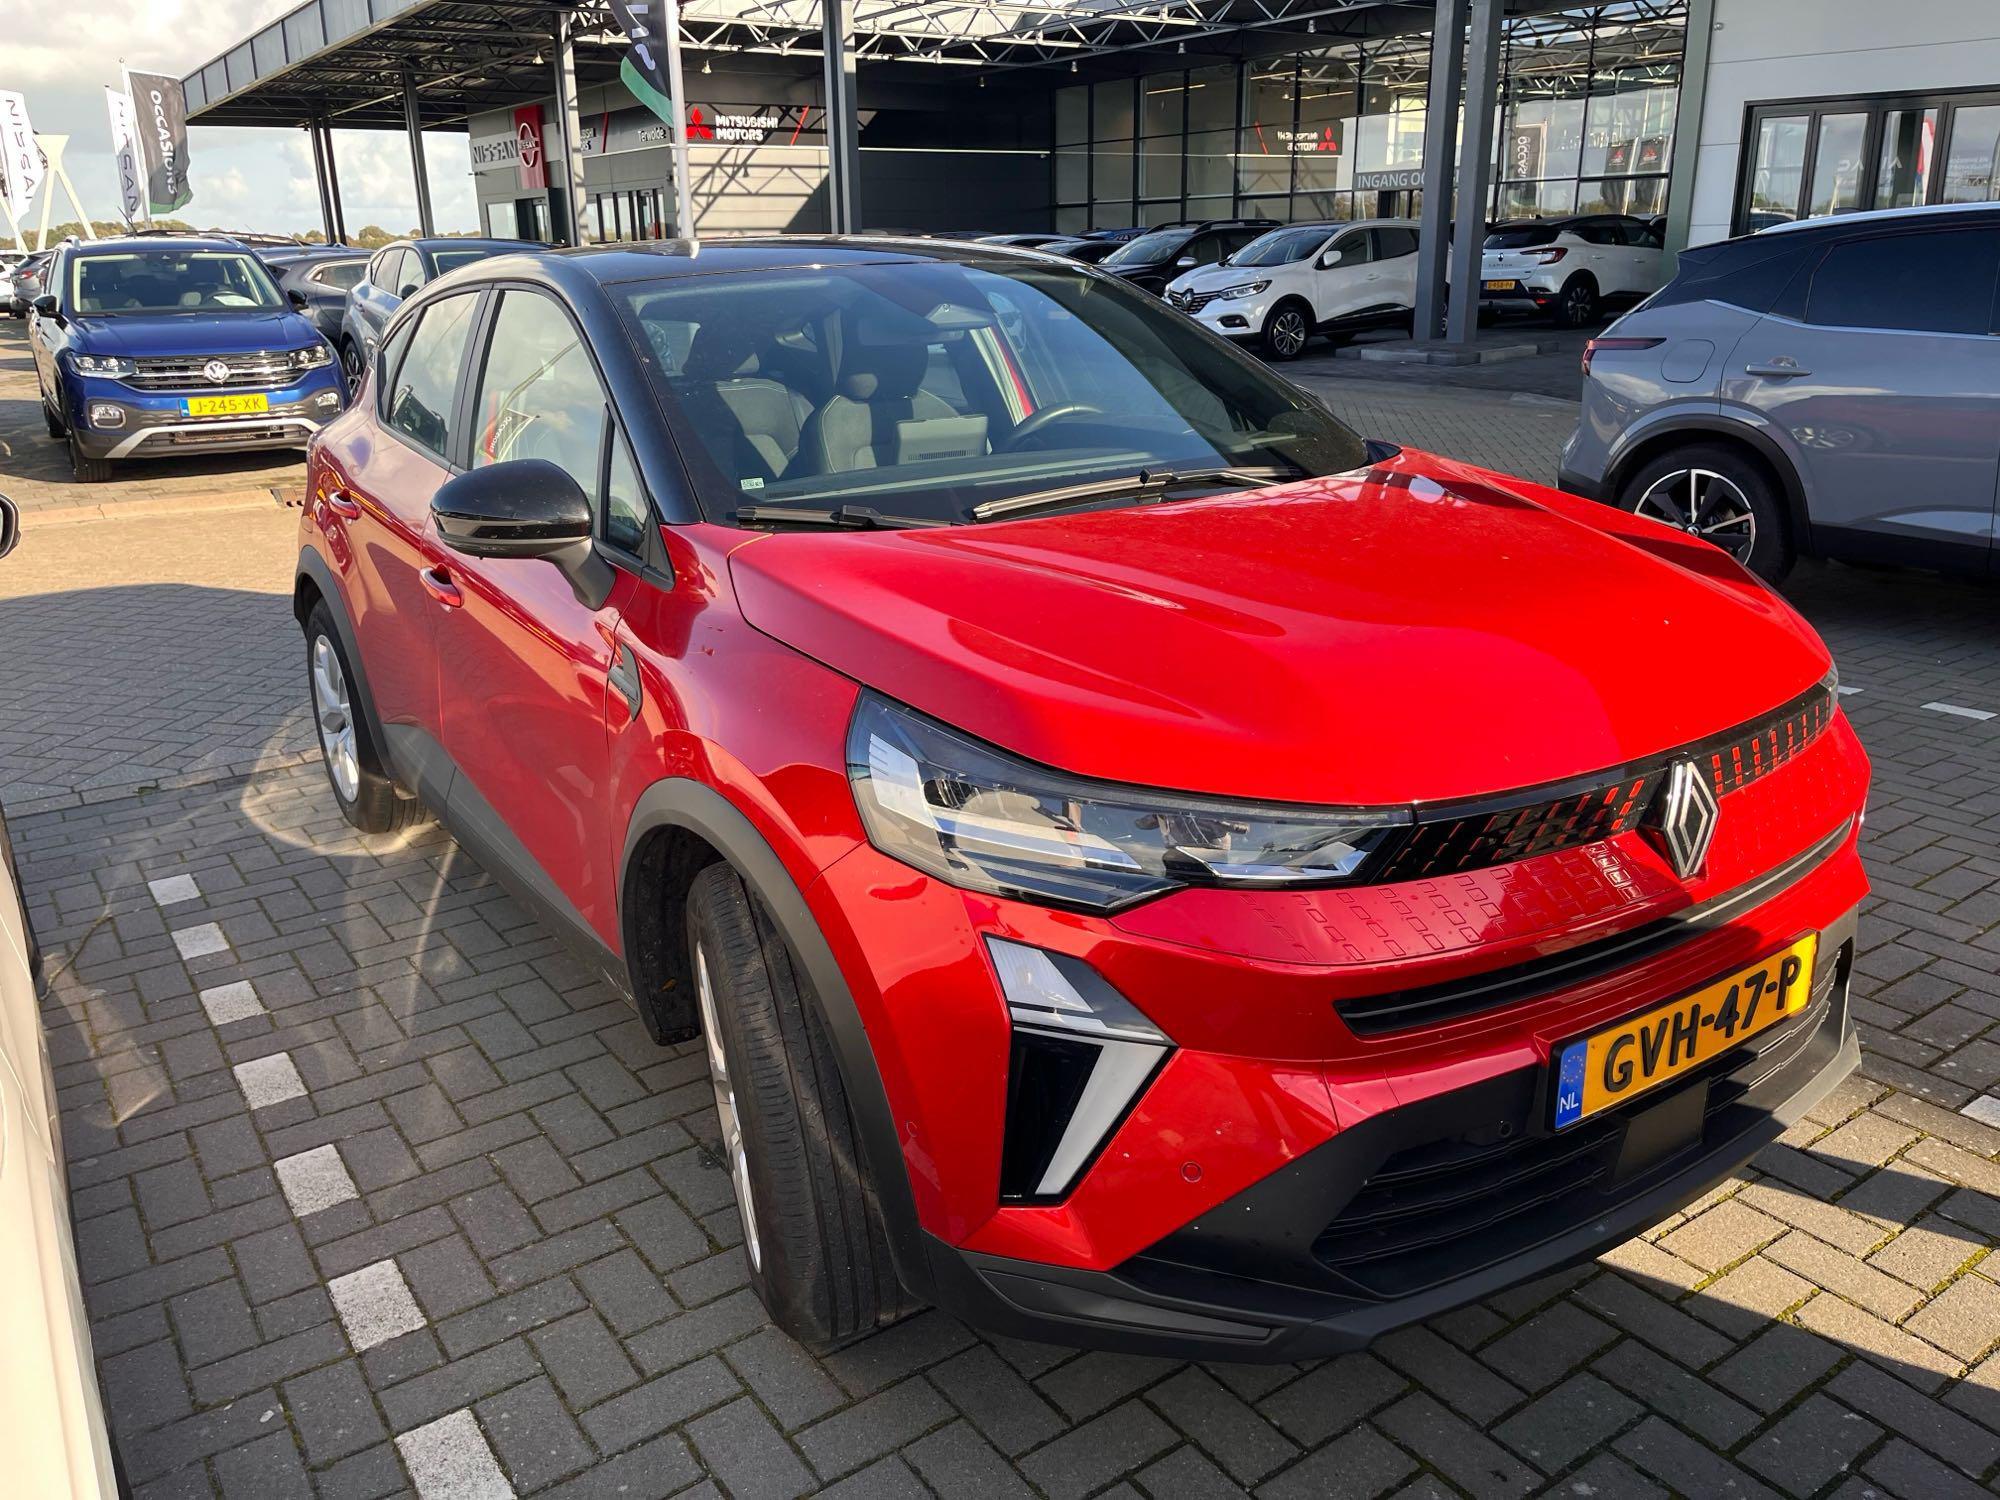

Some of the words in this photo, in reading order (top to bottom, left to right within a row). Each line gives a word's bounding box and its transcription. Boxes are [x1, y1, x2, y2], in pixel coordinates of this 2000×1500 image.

[715, 115, 778, 128] MITSUBISHI
[716, 128, 763, 141] MOTORS
[474, 139, 519, 164] NISSAN
[1357, 172, 1408, 189] INGANG
[195, 398, 262, 413] J-245-XK
[1603, 954, 1801, 1093] GVH-47-P
[1558, 1091, 1579, 1114] NL
